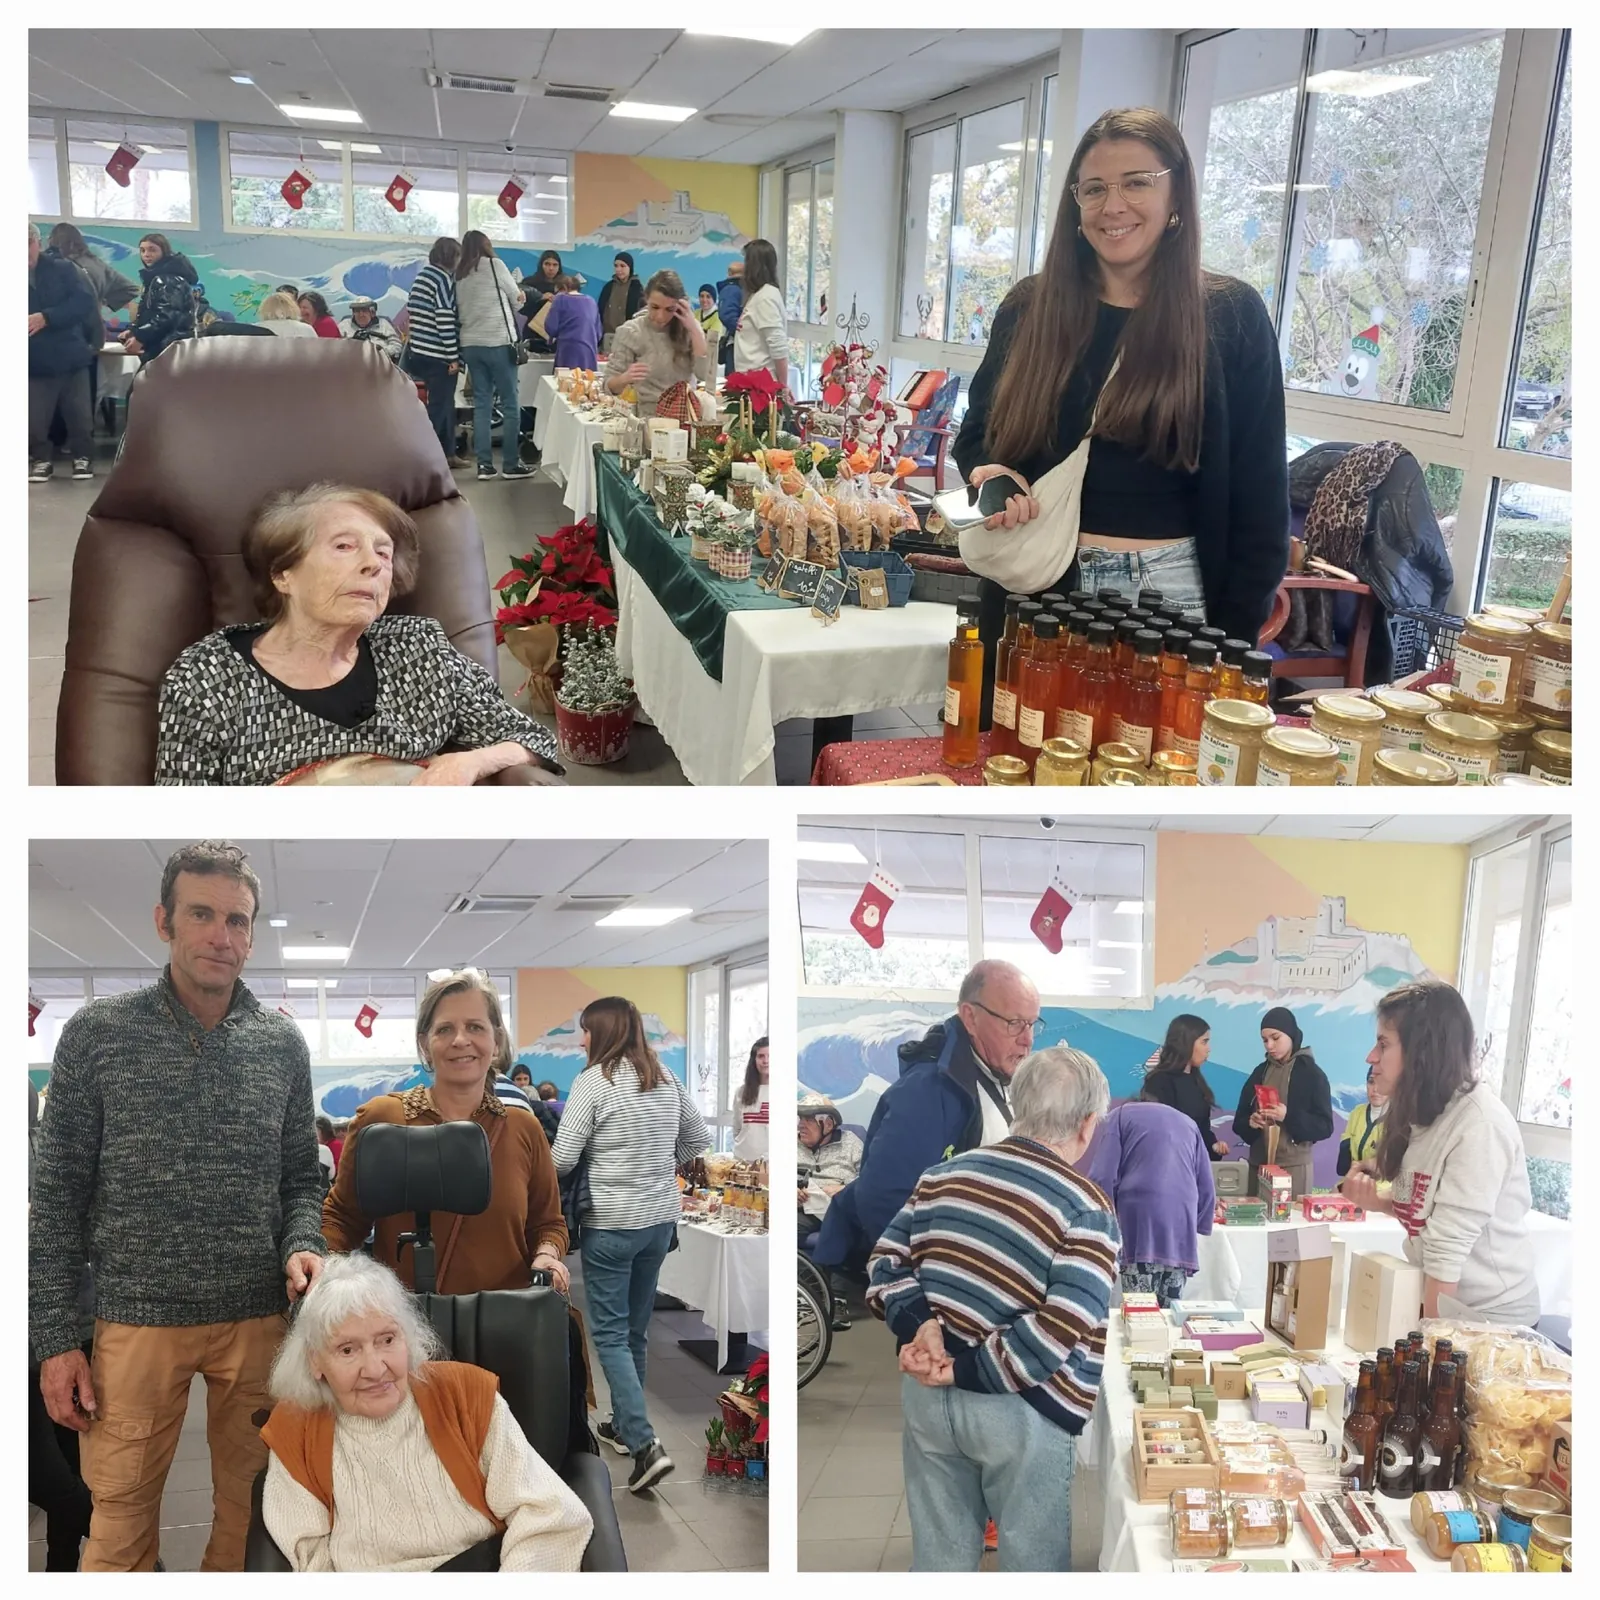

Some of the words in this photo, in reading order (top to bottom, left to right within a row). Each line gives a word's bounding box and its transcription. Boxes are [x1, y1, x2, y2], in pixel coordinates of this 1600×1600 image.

[1478, 653, 1499, 664] Safran
[1400, 728, 1424, 737] Safran
[1210, 737, 1229, 749] Safran
[1500, 752, 1518, 760] afran
[1457, 757, 1482, 766] Safran
